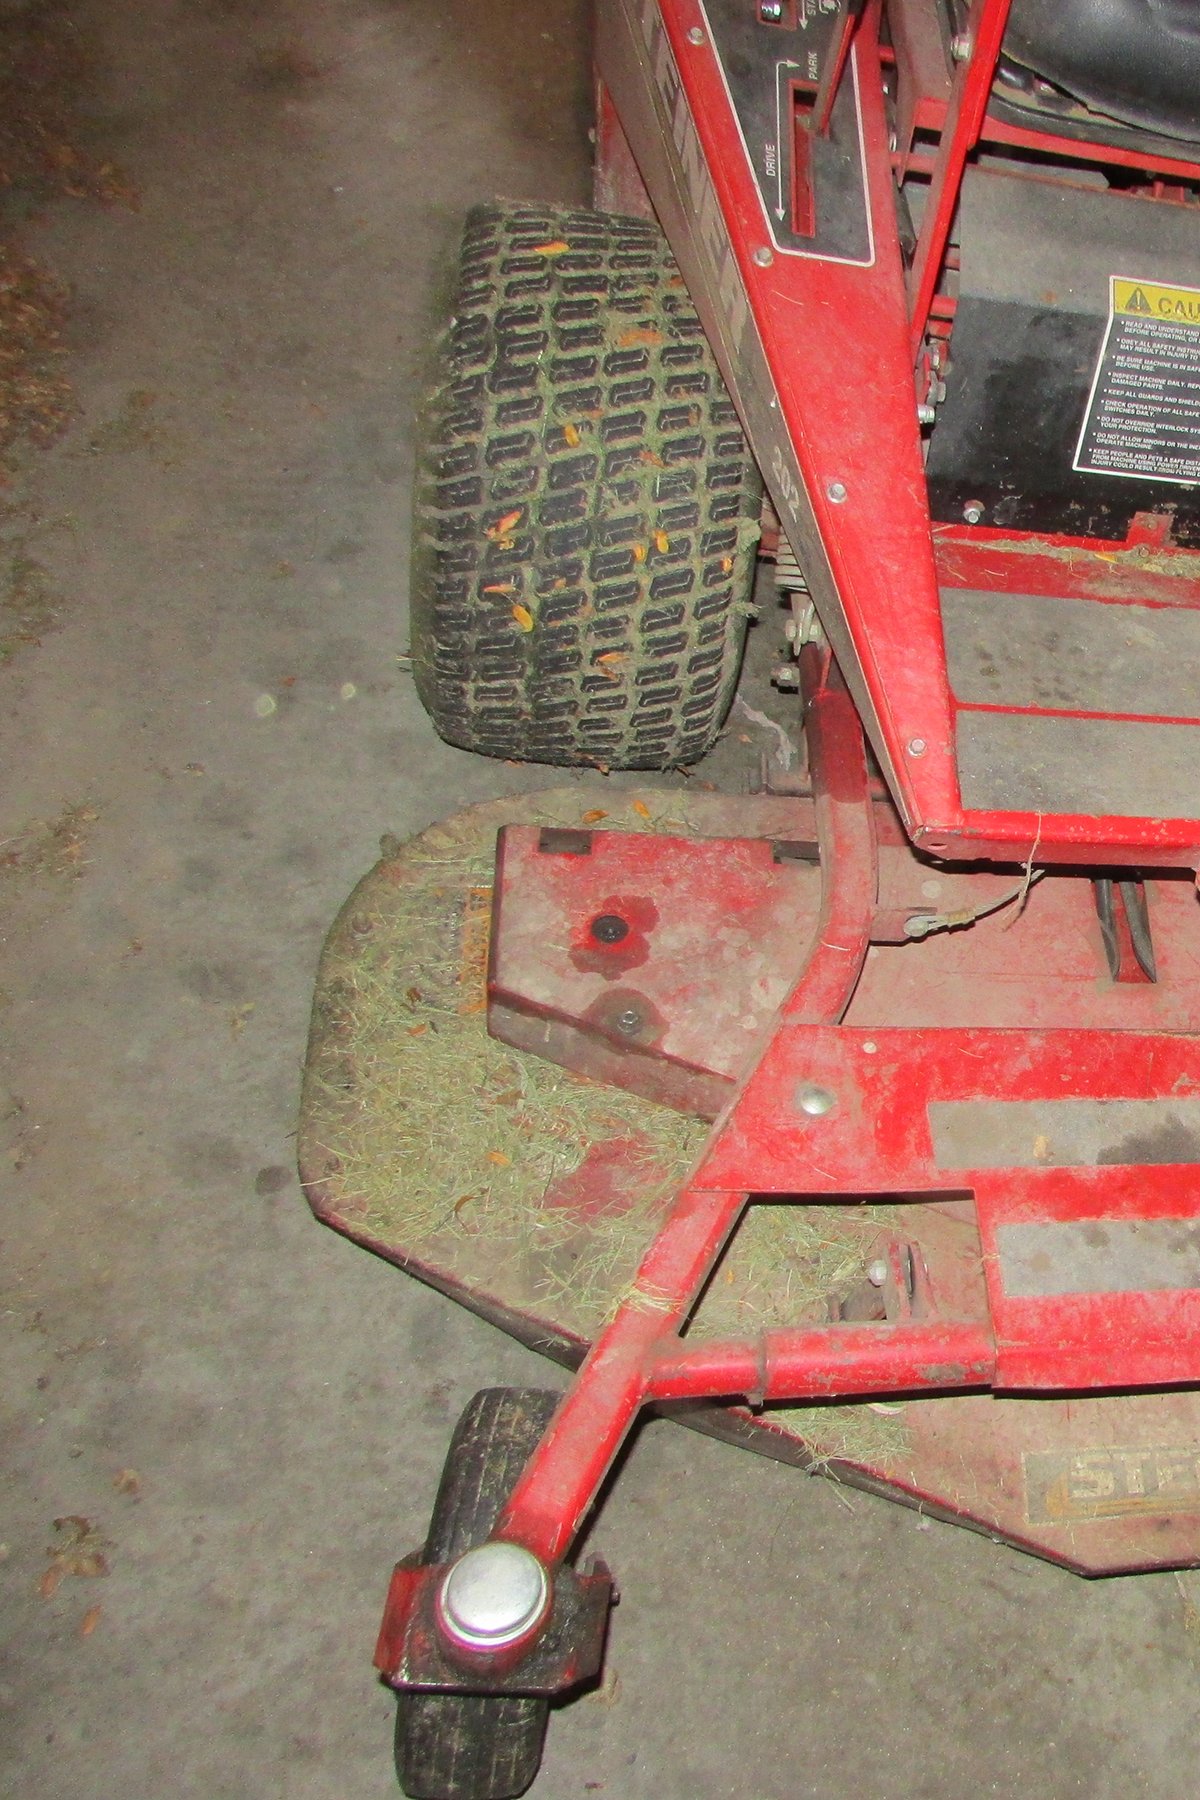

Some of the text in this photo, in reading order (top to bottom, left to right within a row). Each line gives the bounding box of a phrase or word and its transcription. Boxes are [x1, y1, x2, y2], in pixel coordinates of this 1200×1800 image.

[808, 51, 818, 80] PARK
[766, 144, 775, 177] DRIVE
[1124, 327, 1149, 335] BEFORE
[1158, 326, 1199, 337] UNDERSTAND
[1135, 346, 1158, 354] RESULT
[1152, 343, 1174, 351] SAFETY
[1115, 361, 1139, 369] BEFORE
[1144, 359, 1171, 367] MACHINE
[1111, 377, 1141, 386] DAMAGED
[1112, 372, 1137, 380] INSPECT
[1139, 376, 1165, 384] MACHINE
[1138, 393, 1162, 401] GUARDS
[1104, 405, 1134, 414] SWITCHES
[1127, 402, 1161, 412] OPERATION
[1172, 408, 1183, 416] ALL
[1125, 419, 1154, 428] OVERRIDE
[1156, 423, 1188, 432] INTERLOCK
[1096, 437, 1124, 445] OPERATE
